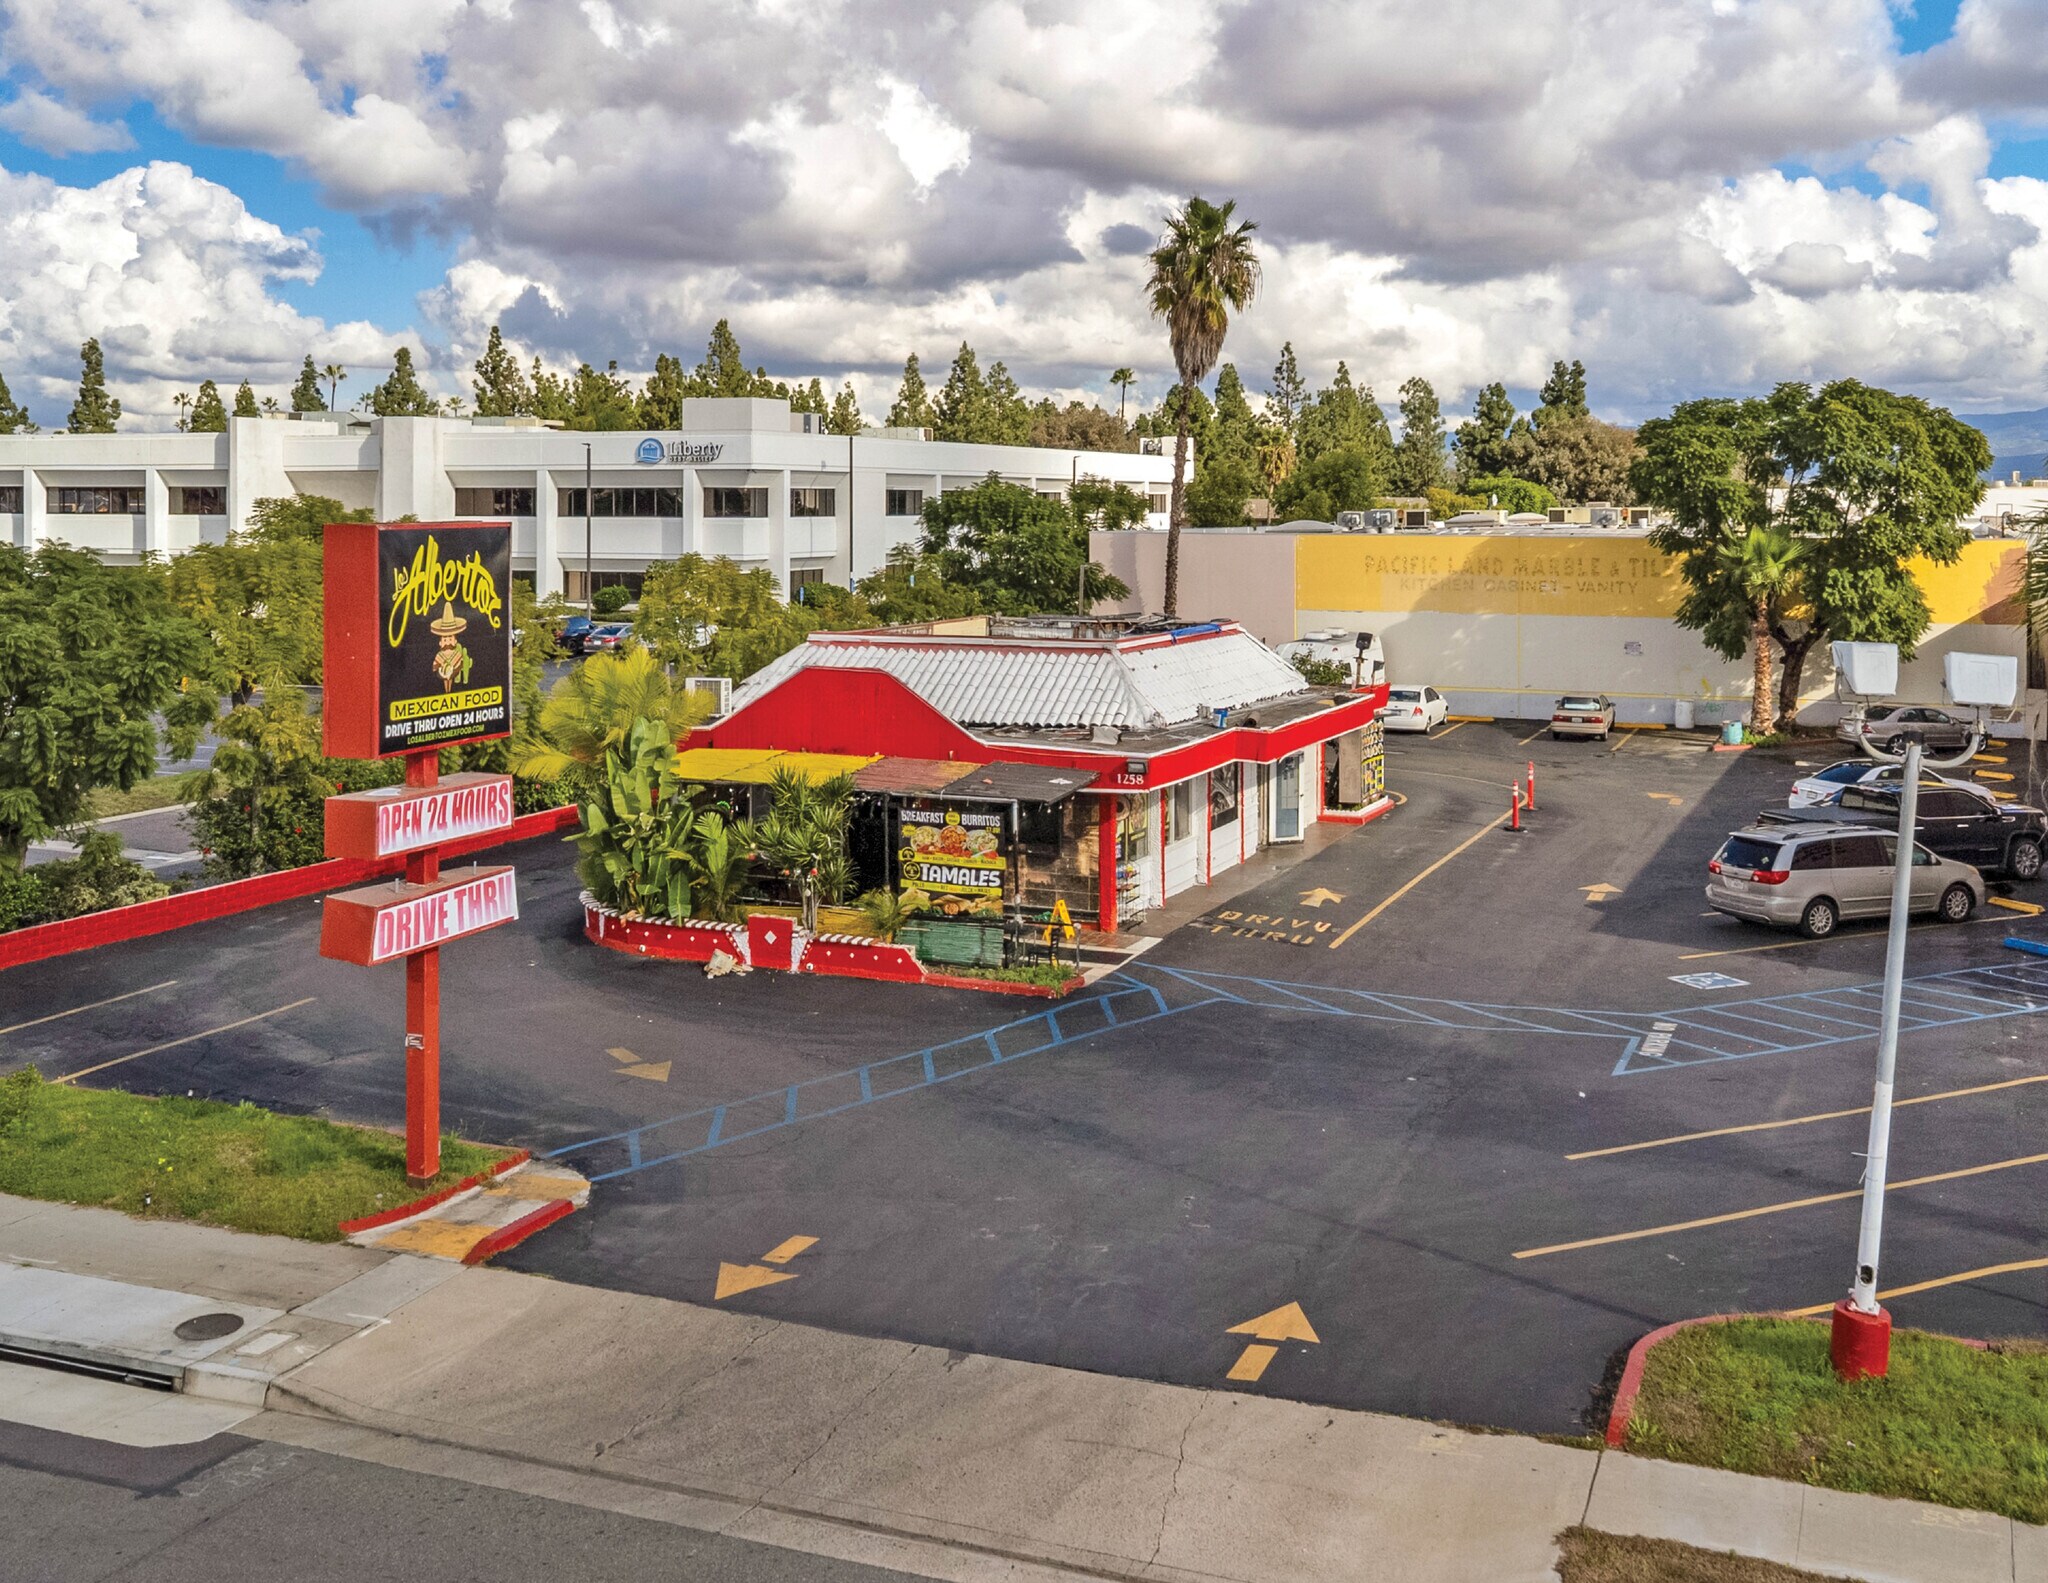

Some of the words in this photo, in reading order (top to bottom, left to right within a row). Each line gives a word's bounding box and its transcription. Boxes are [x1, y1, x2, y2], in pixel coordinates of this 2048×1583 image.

[668, 440, 723, 460] Liberty
[1365, 555, 1437, 575] PACIFIC
[1448, 556, 1503, 576] LAND
[1513, 557, 1600, 577] MARBLE
[1400, 577, 1475, 592] KITCHEN
[1484, 579, 1558, 593] CABINET
[1577, 581, 1639, 594] VANITY
[394, 696, 459, 718] MEXICAN
[465, 690, 500, 707] FOOD
[385, 722, 412, 739] DRIVE
[414, 718, 437, 733] THRU
[438, 713, 463, 730] OPEN
[463, 711, 475, 726] 24
[475, 706, 504, 723] HOURS
[1117, 773, 1144, 785] 1258
[380, 799, 424, 849] OPEN
[427, 795, 449, 836] 24
[452, 782, 509, 831] HOURS
[901, 809, 944, 823] BREAKFAST
[961, 814, 1001, 827] BURRITOS
[920, 863, 1001, 887] TAMALES
[377, 894, 450, 958] DRIVE
[454, 874, 512, 932] THRU
